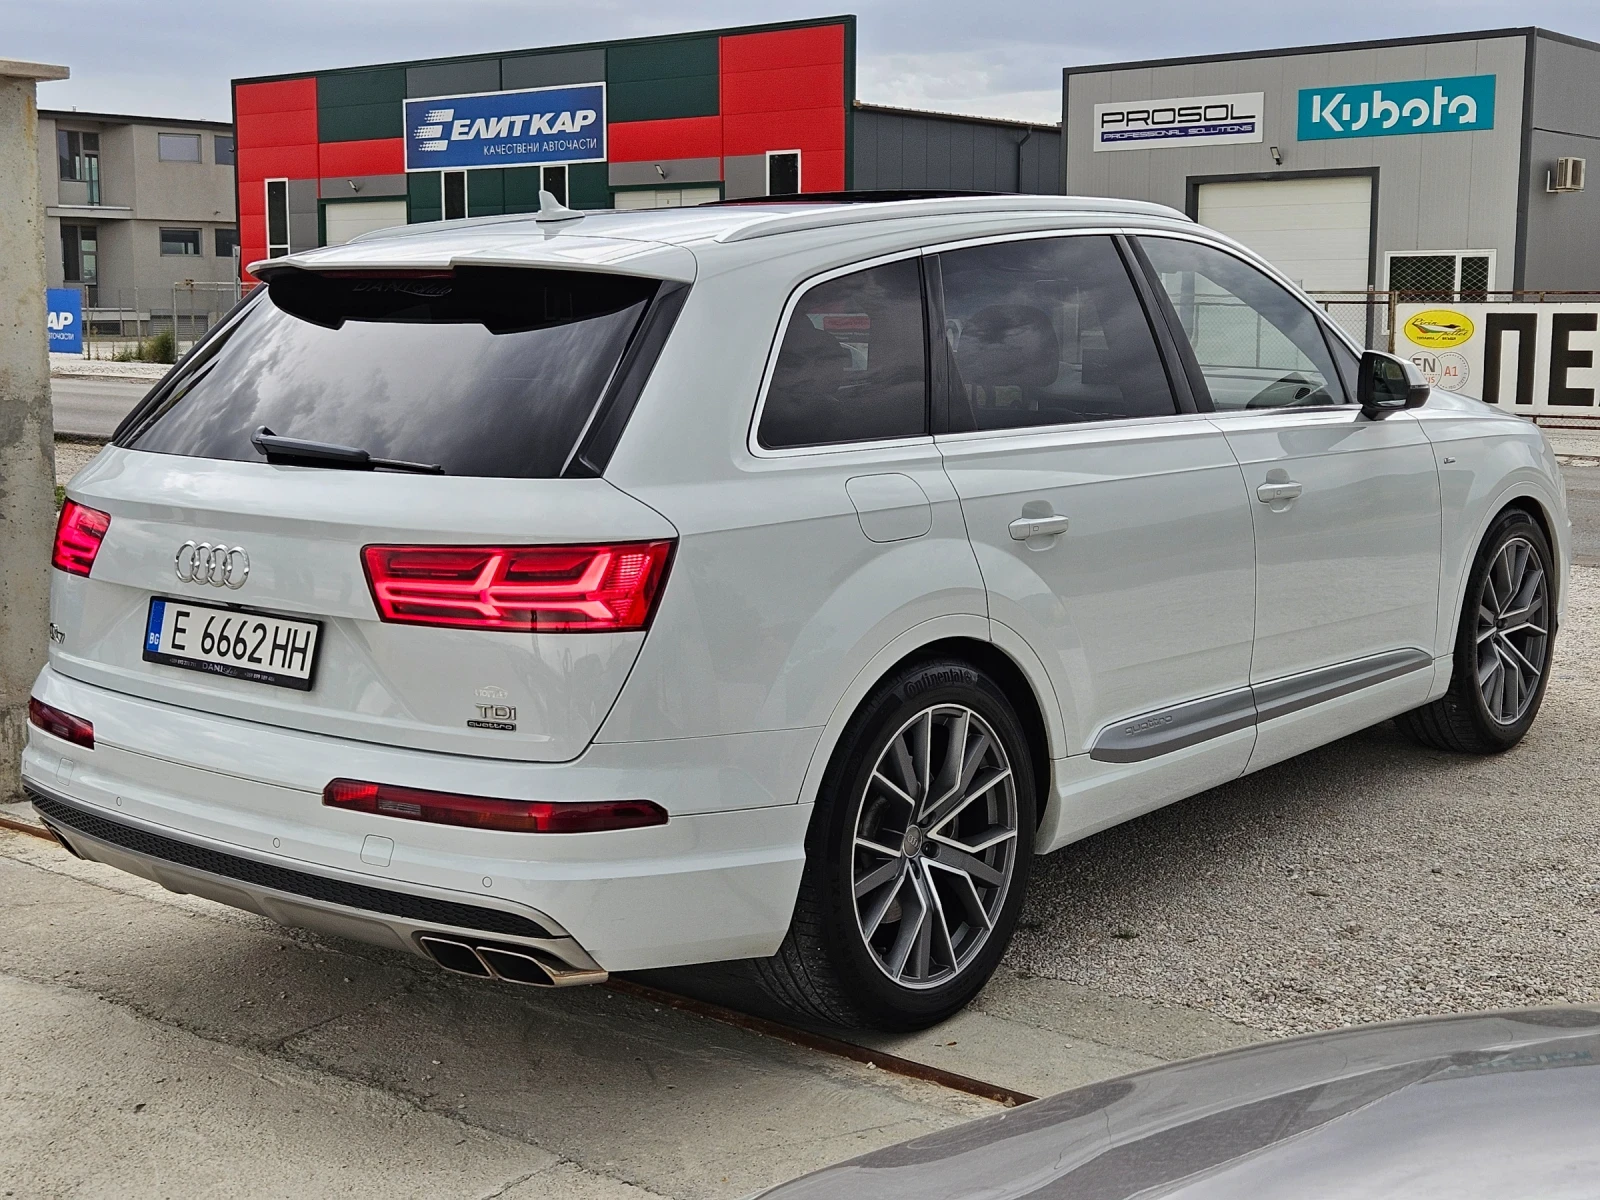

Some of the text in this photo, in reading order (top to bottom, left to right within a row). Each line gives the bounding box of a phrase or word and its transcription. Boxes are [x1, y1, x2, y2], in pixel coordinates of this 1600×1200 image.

[1101, 104, 1256, 129] PROSOL
[1312, 86, 1477, 131] Kubota
[1103, 124, 1253, 141] PROFESSIONAL SOLUTIONS
[483, 138, 597, 156] КАЧЕСТВЕНИ АВТОЧАСТИ
[48, 311, 74, 330] АР
[1482, 312, 1600, 407] ПЕ
[1444, 365, 1459, 377] A1
[149, 632, 160, 645] BG
[171, 610, 191, 651] E
[202, 662, 223, 673] DANI
[903, 668, 965, 699] Continental
[468, 720, 513, 731] quattro
[1125, 715, 1173, 736] quattro
